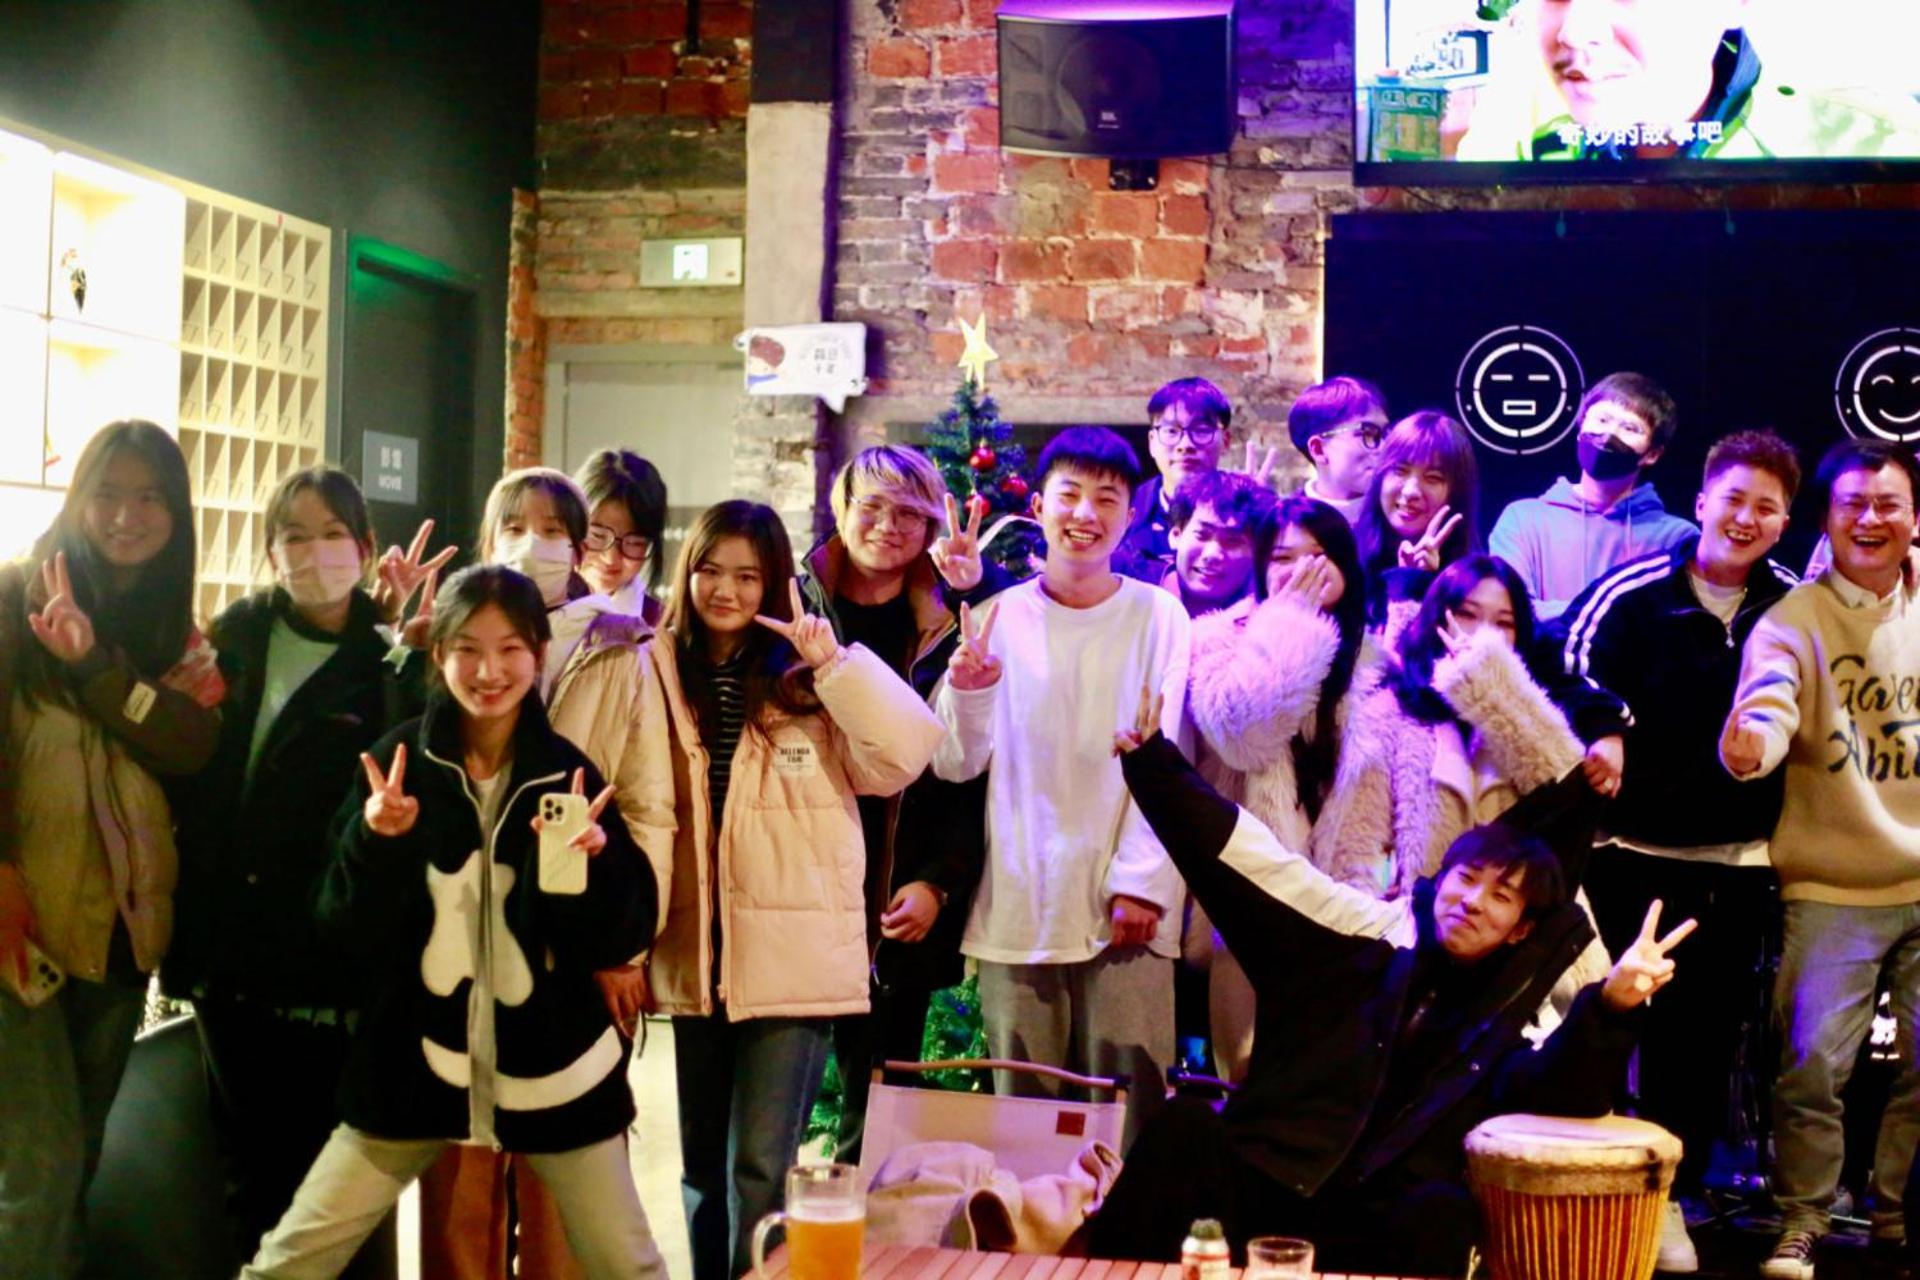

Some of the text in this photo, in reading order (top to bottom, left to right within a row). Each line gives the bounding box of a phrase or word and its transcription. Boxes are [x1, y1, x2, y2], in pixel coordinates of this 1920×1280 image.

[1557, 120, 1723, 147] 奇妙的故事吧
